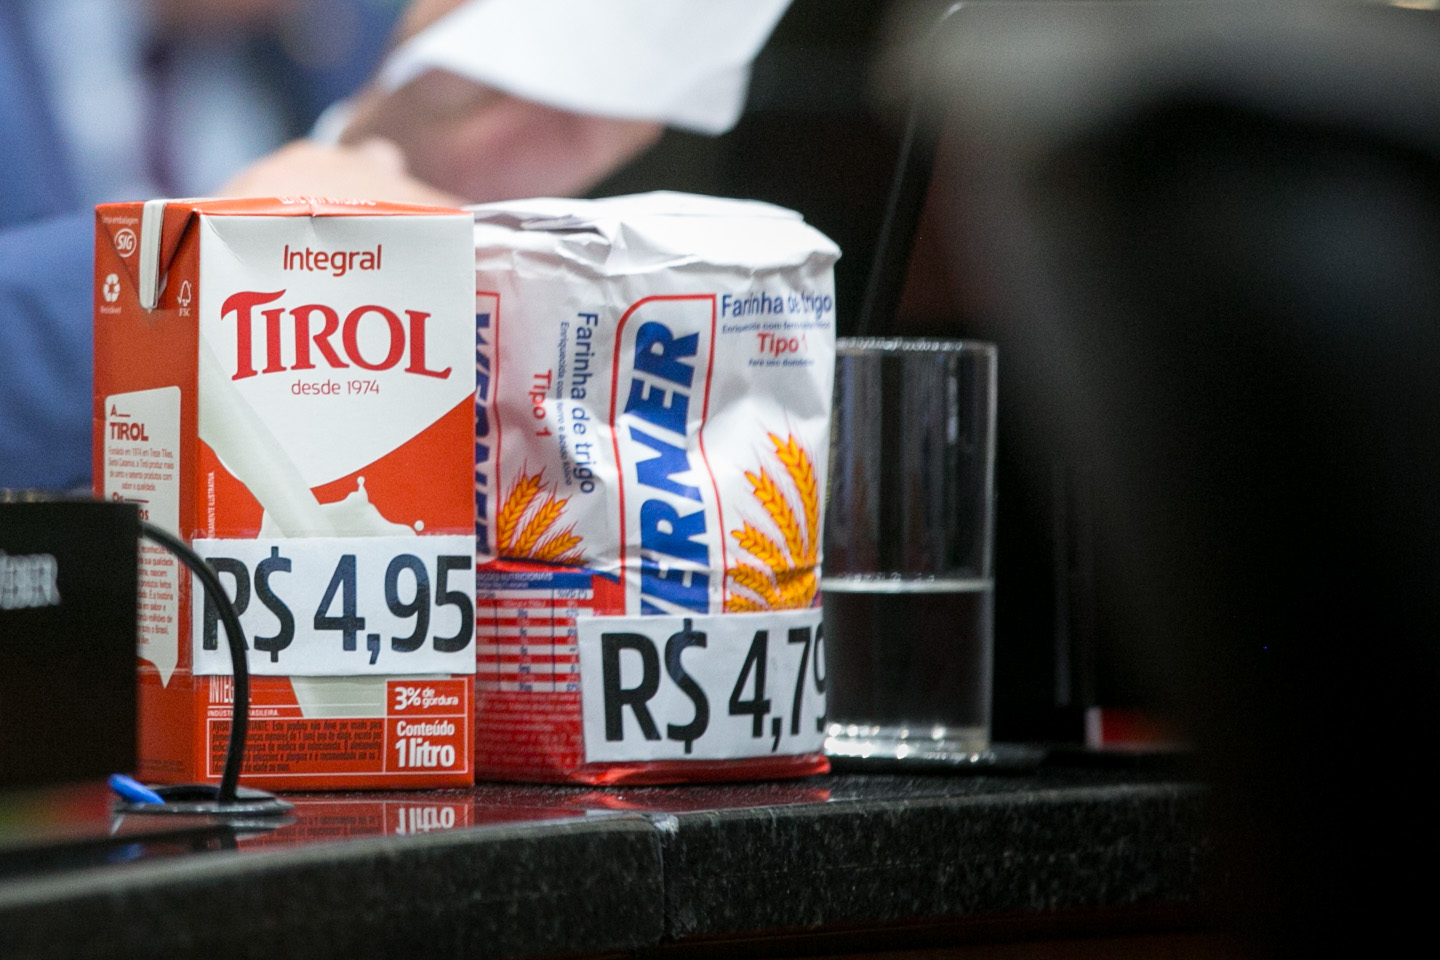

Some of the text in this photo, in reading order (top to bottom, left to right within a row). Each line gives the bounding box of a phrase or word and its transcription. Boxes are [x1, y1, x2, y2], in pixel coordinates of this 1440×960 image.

[117, 234, 133, 250] SIG
[283, 244, 382, 276] Integral
[722, 291, 784, 318] Farinha
[221, 289, 452, 381] TIROL
[757, 332, 799, 358] Tipo
[291, 380, 380, 396] desde 1974
[529, 368, 552, 437] Tipo 1
[571, 312, 599, 494] Farinha de trigo
[110, 422, 149, 442] TIROL
[623, 321, 709, 615] ERNER
[203, 546, 295, 663] R$
[313, 553, 474, 665] 4,95
[394, 686, 459, 710] 3% de gordura
[600, 618, 709, 754] R$
[728, 622, 827, 753] 4,79
[397, 720, 455, 737] Conteúdo
